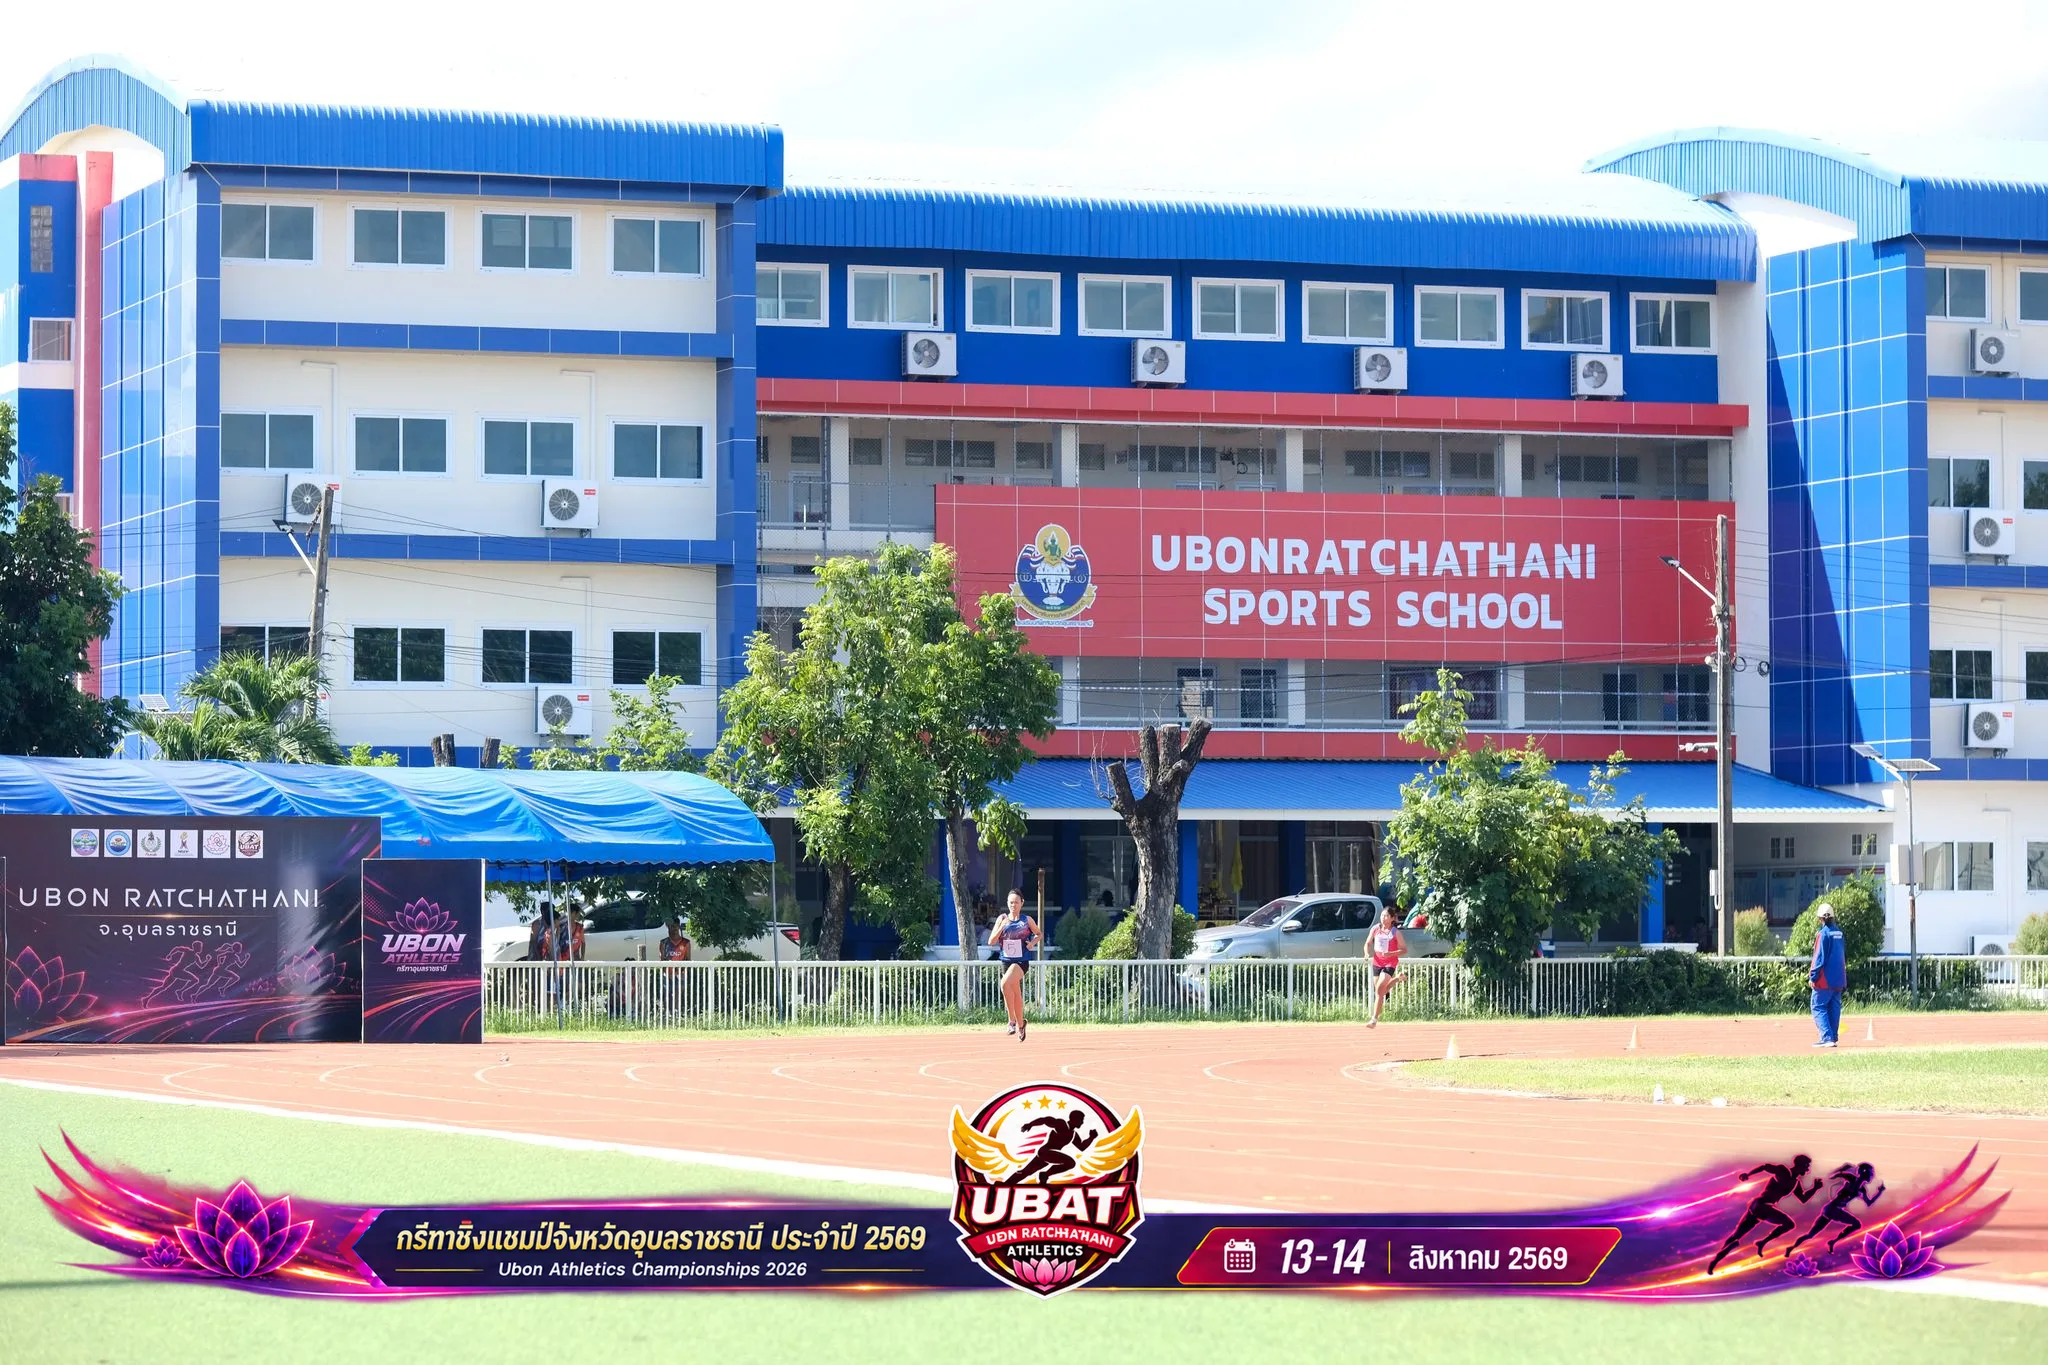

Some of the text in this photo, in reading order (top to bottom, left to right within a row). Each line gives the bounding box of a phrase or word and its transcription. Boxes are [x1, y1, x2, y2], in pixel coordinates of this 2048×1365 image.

[1152, 534, 1596, 579] UBONRATCHATHANI
[1204, 587, 1563, 630] SPORTS SCHOOL
[19, 887, 318, 908] UBON RATCHATHANI
[382, 933, 466, 953] UBON
[1007, 943, 1016, 956] 5
[383, 953, 462, 963] ATHLETICS
